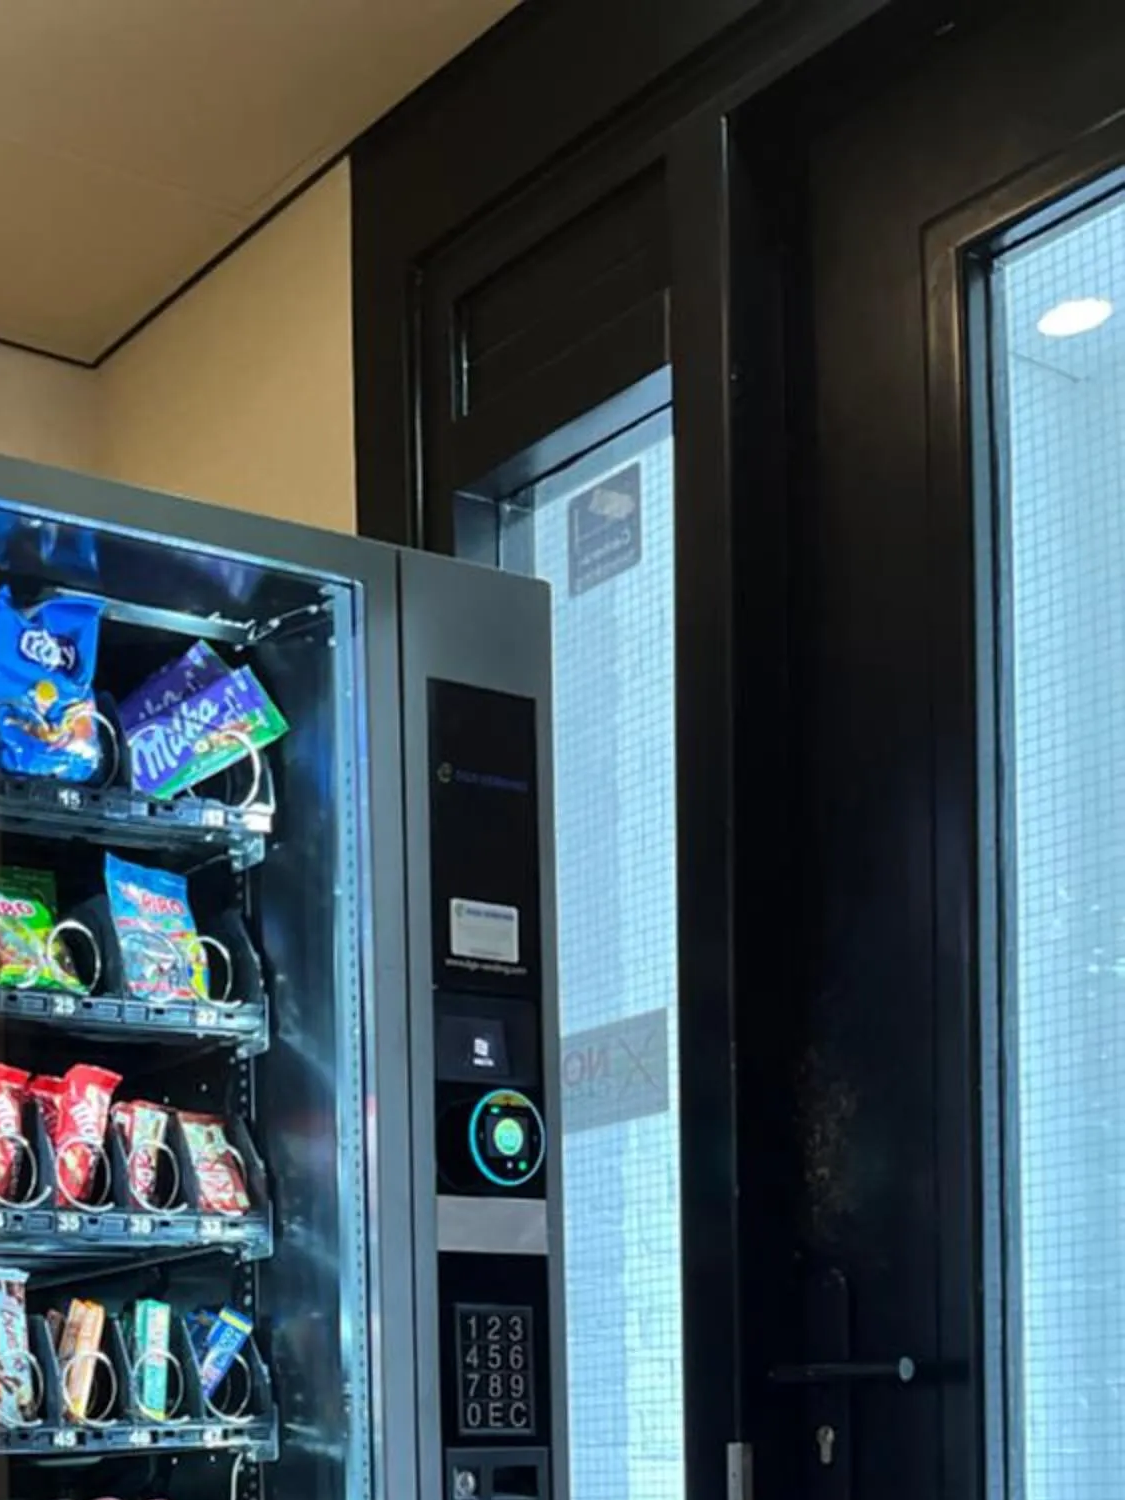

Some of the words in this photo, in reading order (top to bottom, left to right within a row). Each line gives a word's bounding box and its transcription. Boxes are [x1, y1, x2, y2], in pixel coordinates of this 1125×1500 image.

[127, 697, 219, 781] Milka
[467, 1315, 476, 1339] 1
[487, 1315, 501, 1341] 2
[508, 1315, 523, 1341] 3
[466, 1344, 479, 1368] 4
[487, 1344, 502, 1369] 5
[509, 1344, 524, 1369] 6
[466, 1373, 480, 1397] 7
[488, 1373, 502, 1398] 8
[510, 1373, 524, 1398] 9
[467, 1402, 481, 1427] 0
[489, 1402, 503, 1427] E
[510, 1402, 527, 1427] C
